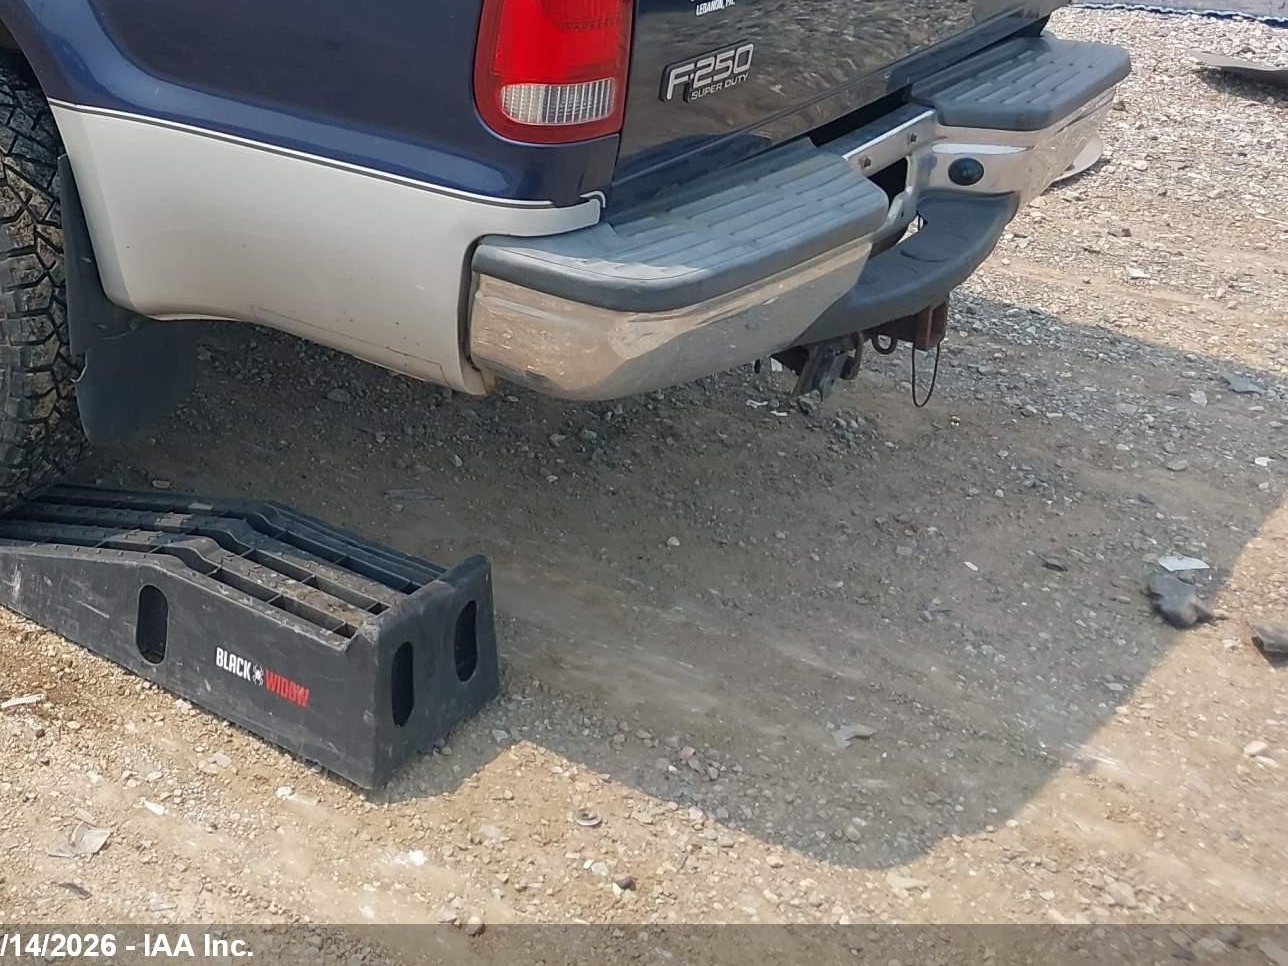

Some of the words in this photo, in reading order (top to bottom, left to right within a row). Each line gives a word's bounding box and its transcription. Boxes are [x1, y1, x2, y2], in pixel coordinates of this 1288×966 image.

[691, 82, 723, 101] SUPER
[724, 72, 749, 89] DUTY
[215, 646, 252, 682] BLACK
[265, 668, 310, 708] WIDOW
